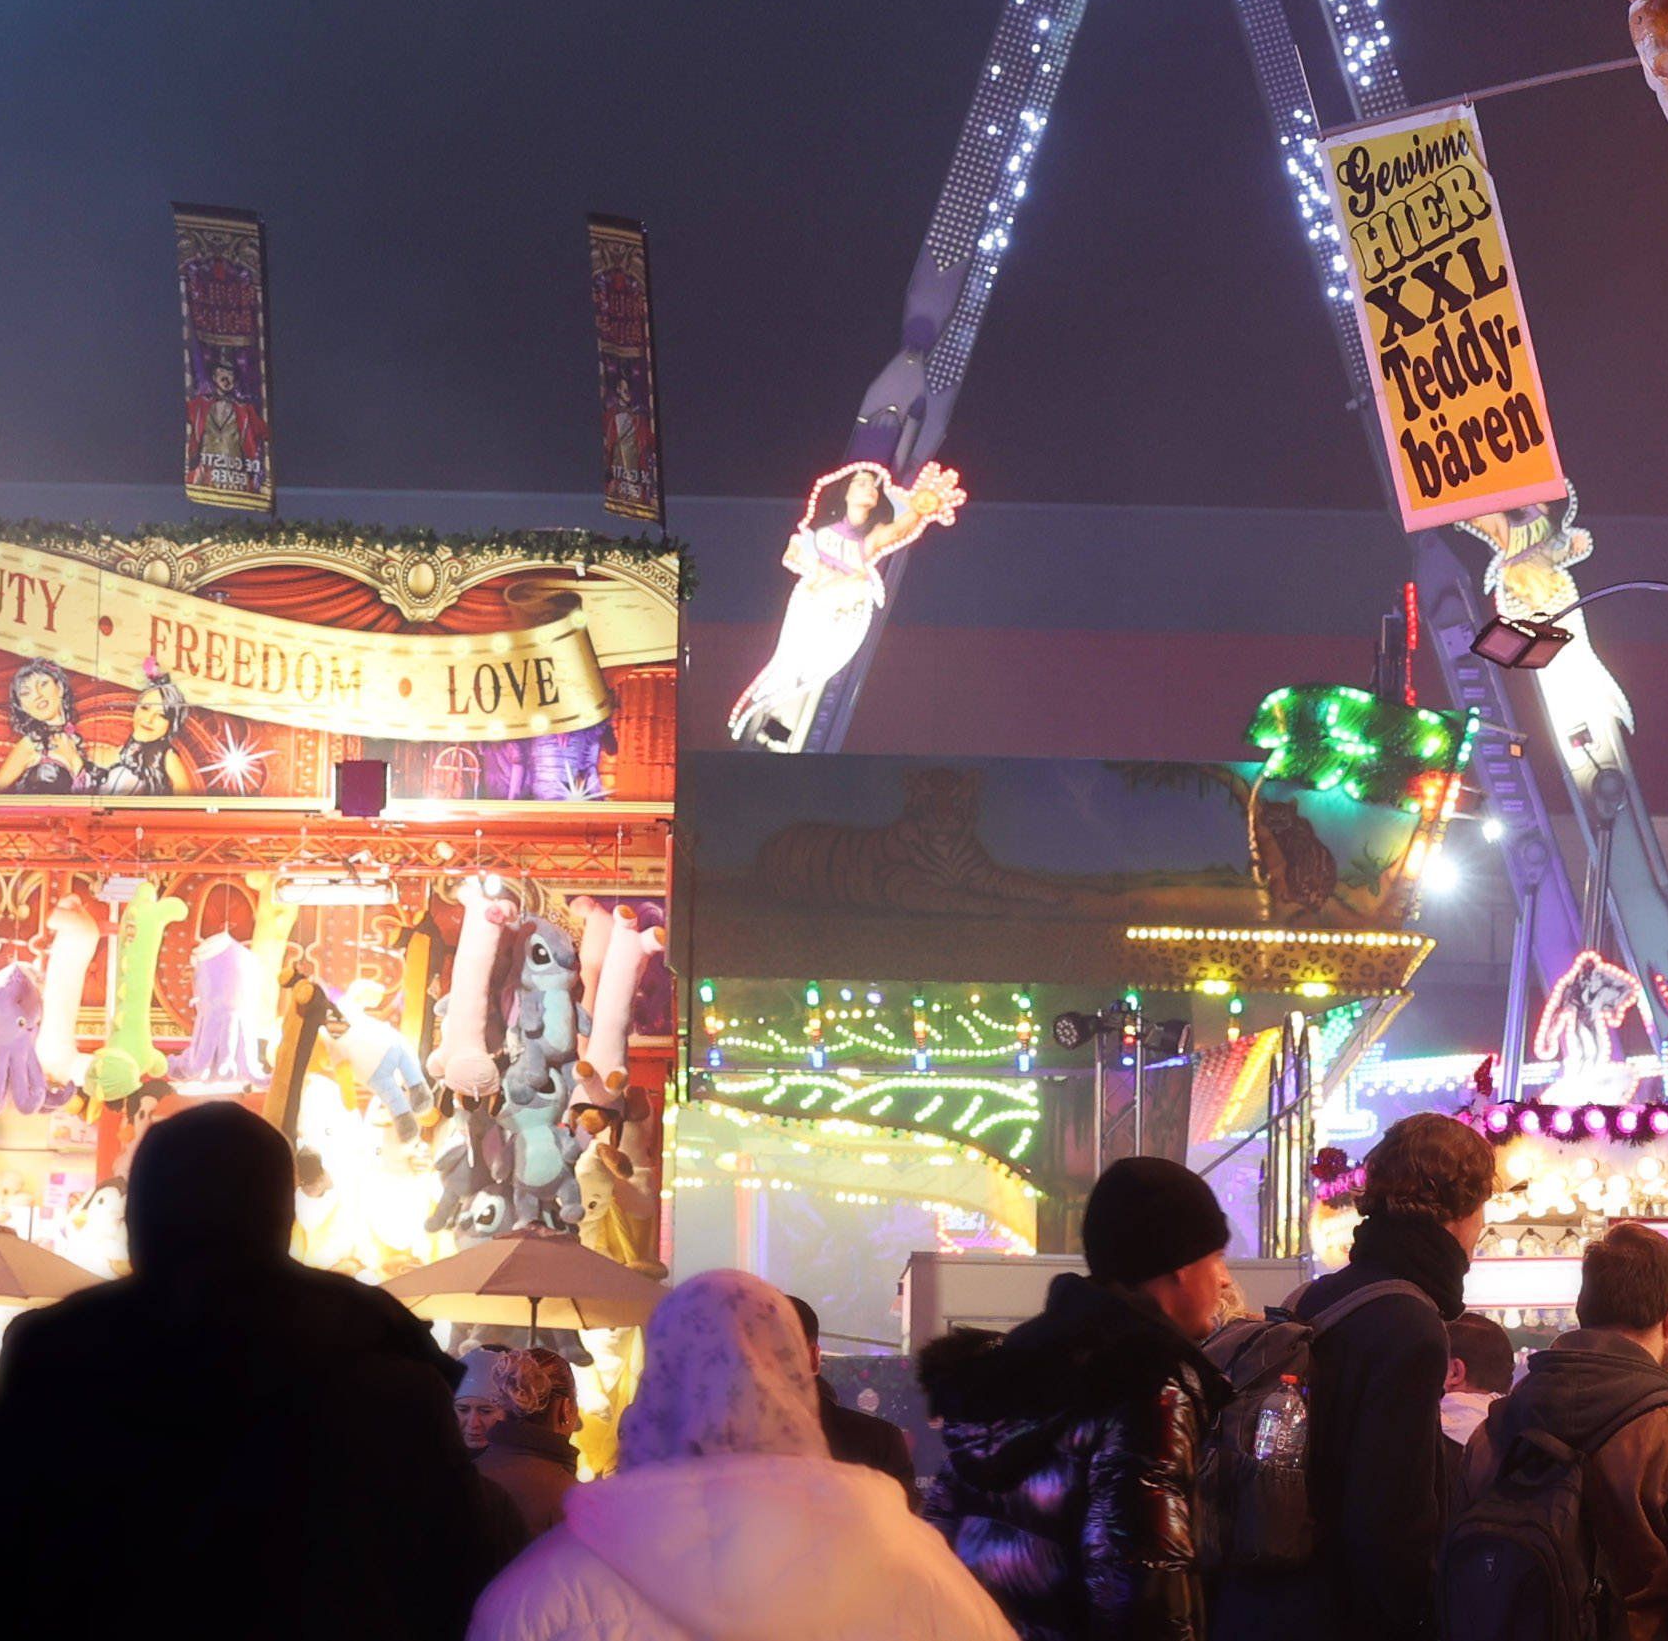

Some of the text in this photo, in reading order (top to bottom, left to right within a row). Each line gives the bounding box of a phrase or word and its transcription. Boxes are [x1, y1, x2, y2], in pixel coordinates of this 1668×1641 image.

[1336, 129, 1470, 218] Gewinne
[1351, 165, 1492, 284] HIER
[1364, 236, 1508, 347] XXL
[1380, 308, 1522, 422] Teddy-
[1400, 392, 1544, 498] bären
[149, 615, 365, 707] FREEDOM
[447, 656, 560, 715] LOVE
